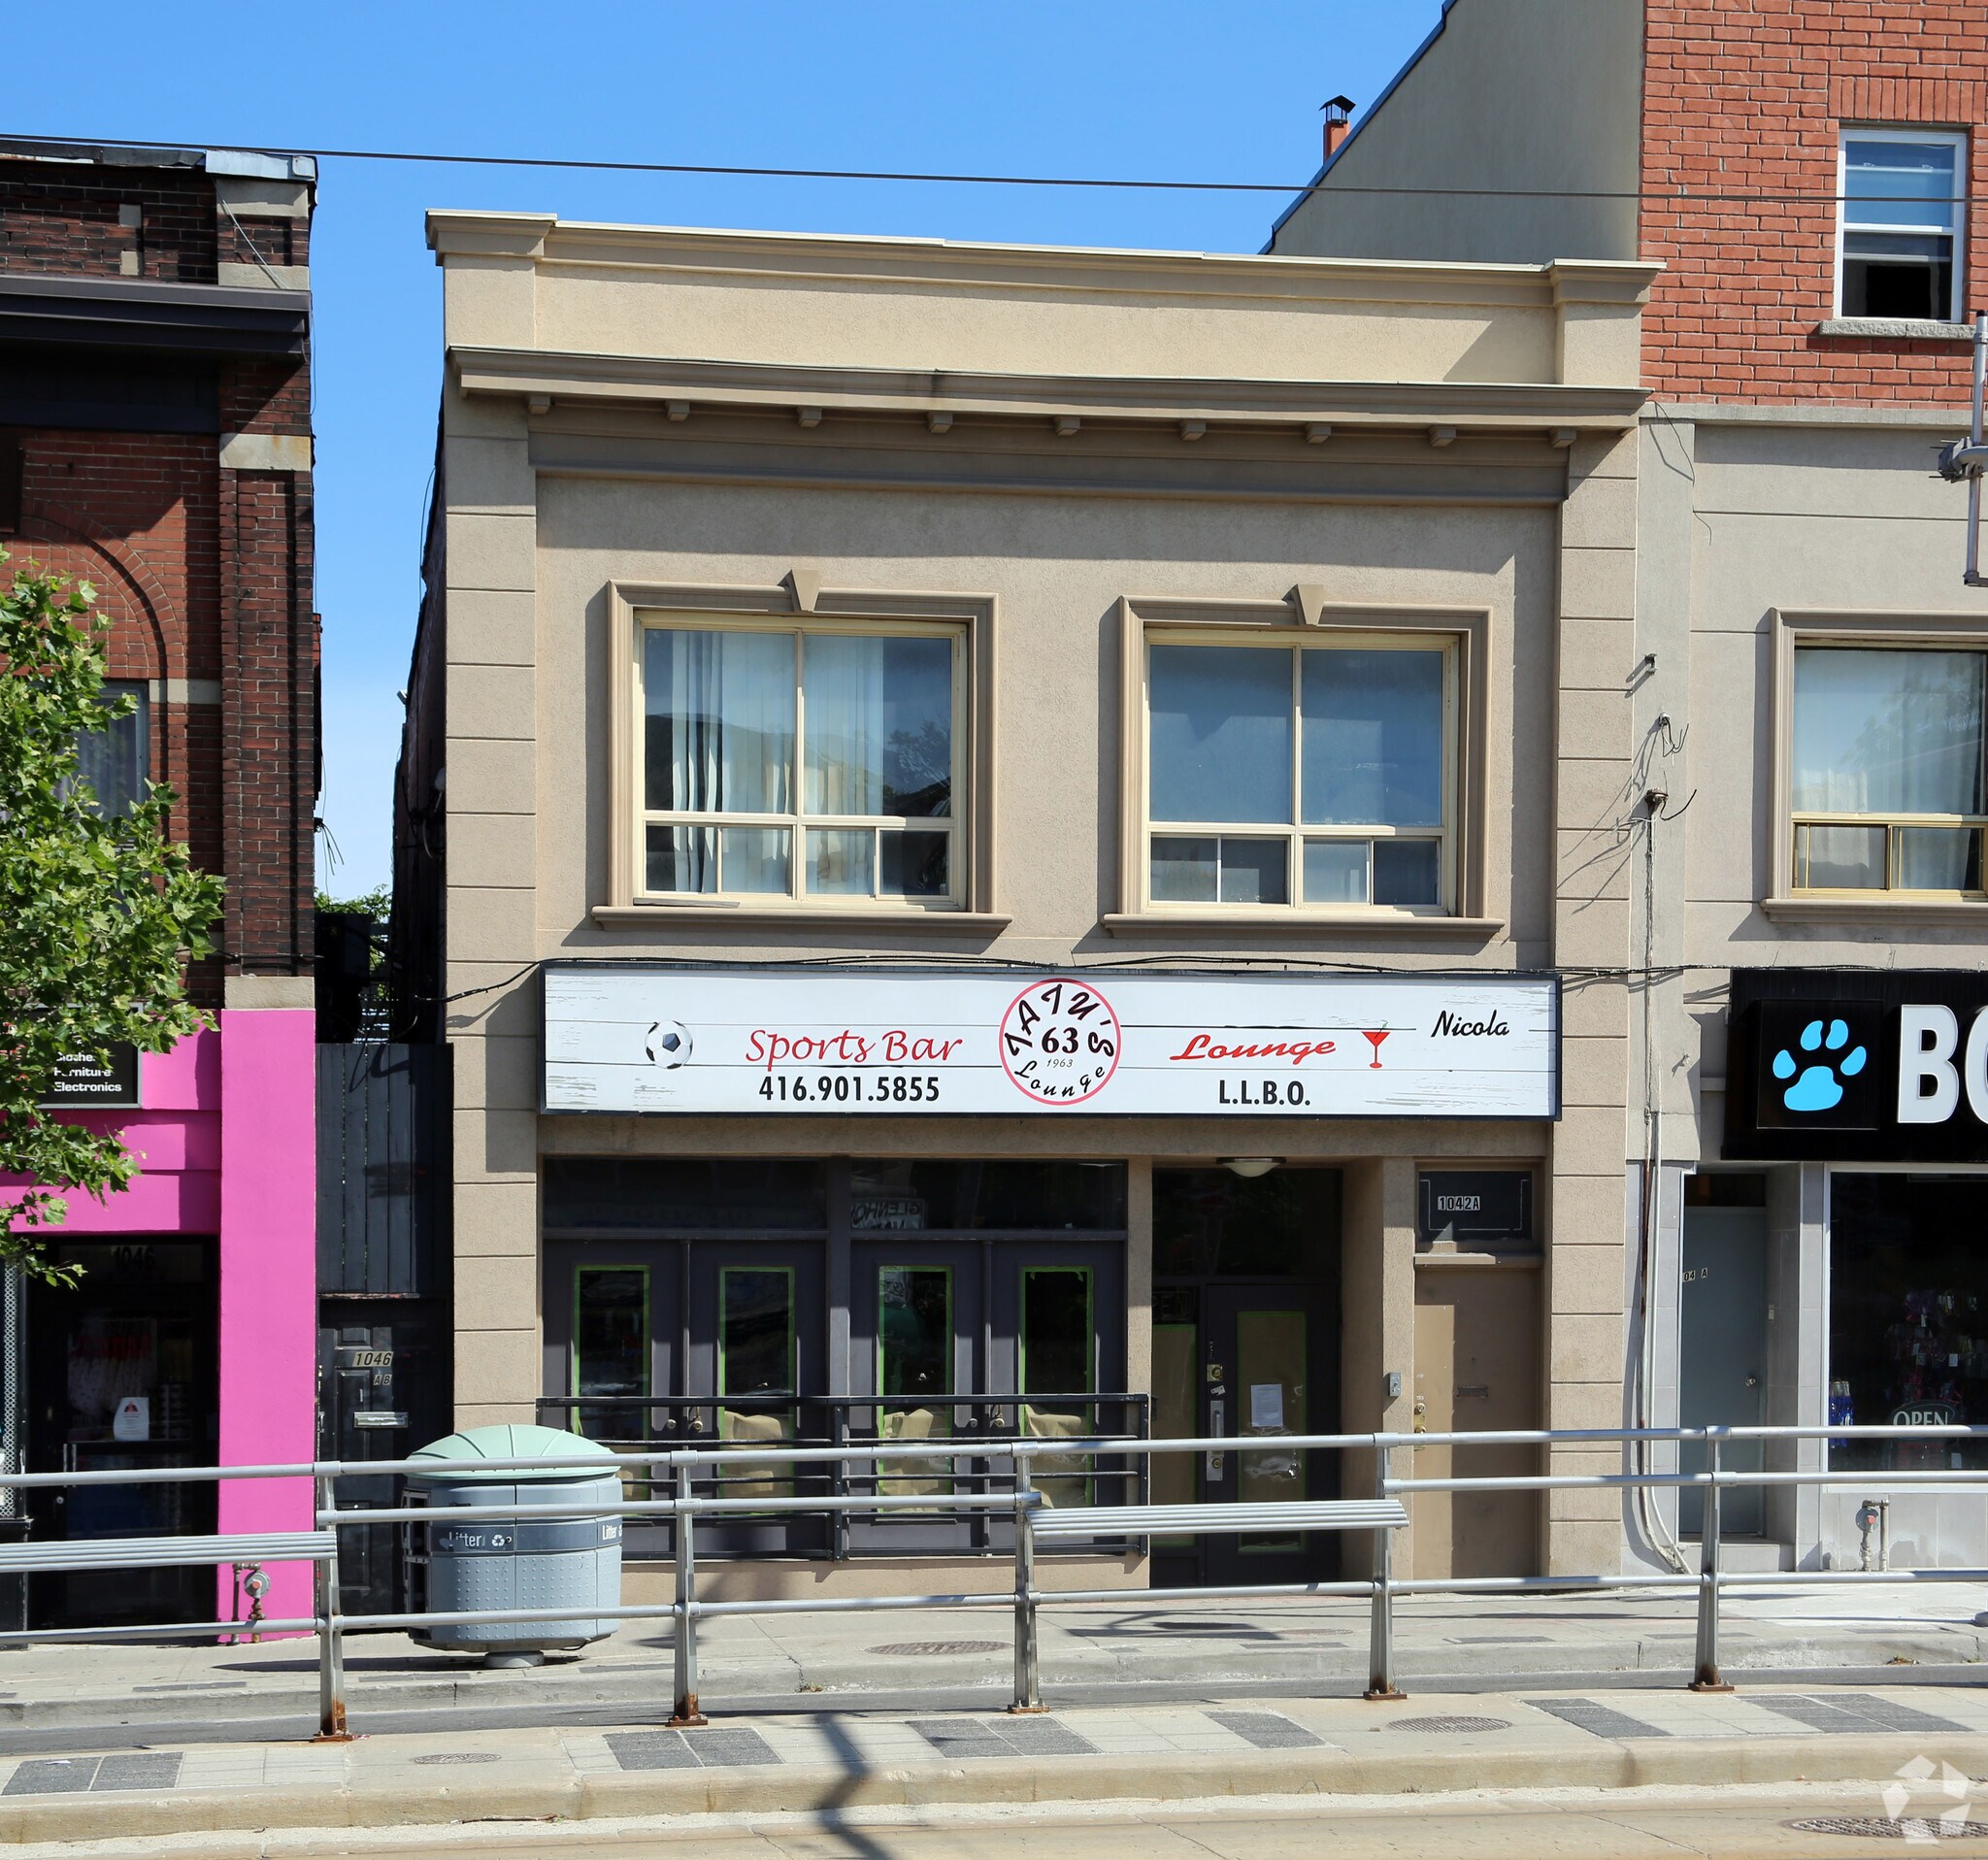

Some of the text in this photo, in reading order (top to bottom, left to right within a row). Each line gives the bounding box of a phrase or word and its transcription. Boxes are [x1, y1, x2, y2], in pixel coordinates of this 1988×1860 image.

[1430, 1009, 1510, 1038] Nicola
[746, 1029, 963, 1073] Sports Bar
[1041, 1027, 1079, 1053] 63
[1170, 1033, 1336, 1066] Lounge
[53, 1066, 112, 1077] Frniture
[1046, 1058, 1074, 1069] 1963
[53, 1081, 122, 1092] Electronics
[758, 1076, 940, 1102] 416.901.5855
[1013, 1060, 1106, 1098] Lounge
[1219, 1079, 1310, 1106] L.L.B.O.
[1439, 1196, 1479, 1210] 1042A
[114, 1246, 156, 1270] 1046
[356, 1352, 392, 1366] 1046
[1893, 1411, 1948, 1426] OPEN
[602, 1524, 617, 1541] Litter
